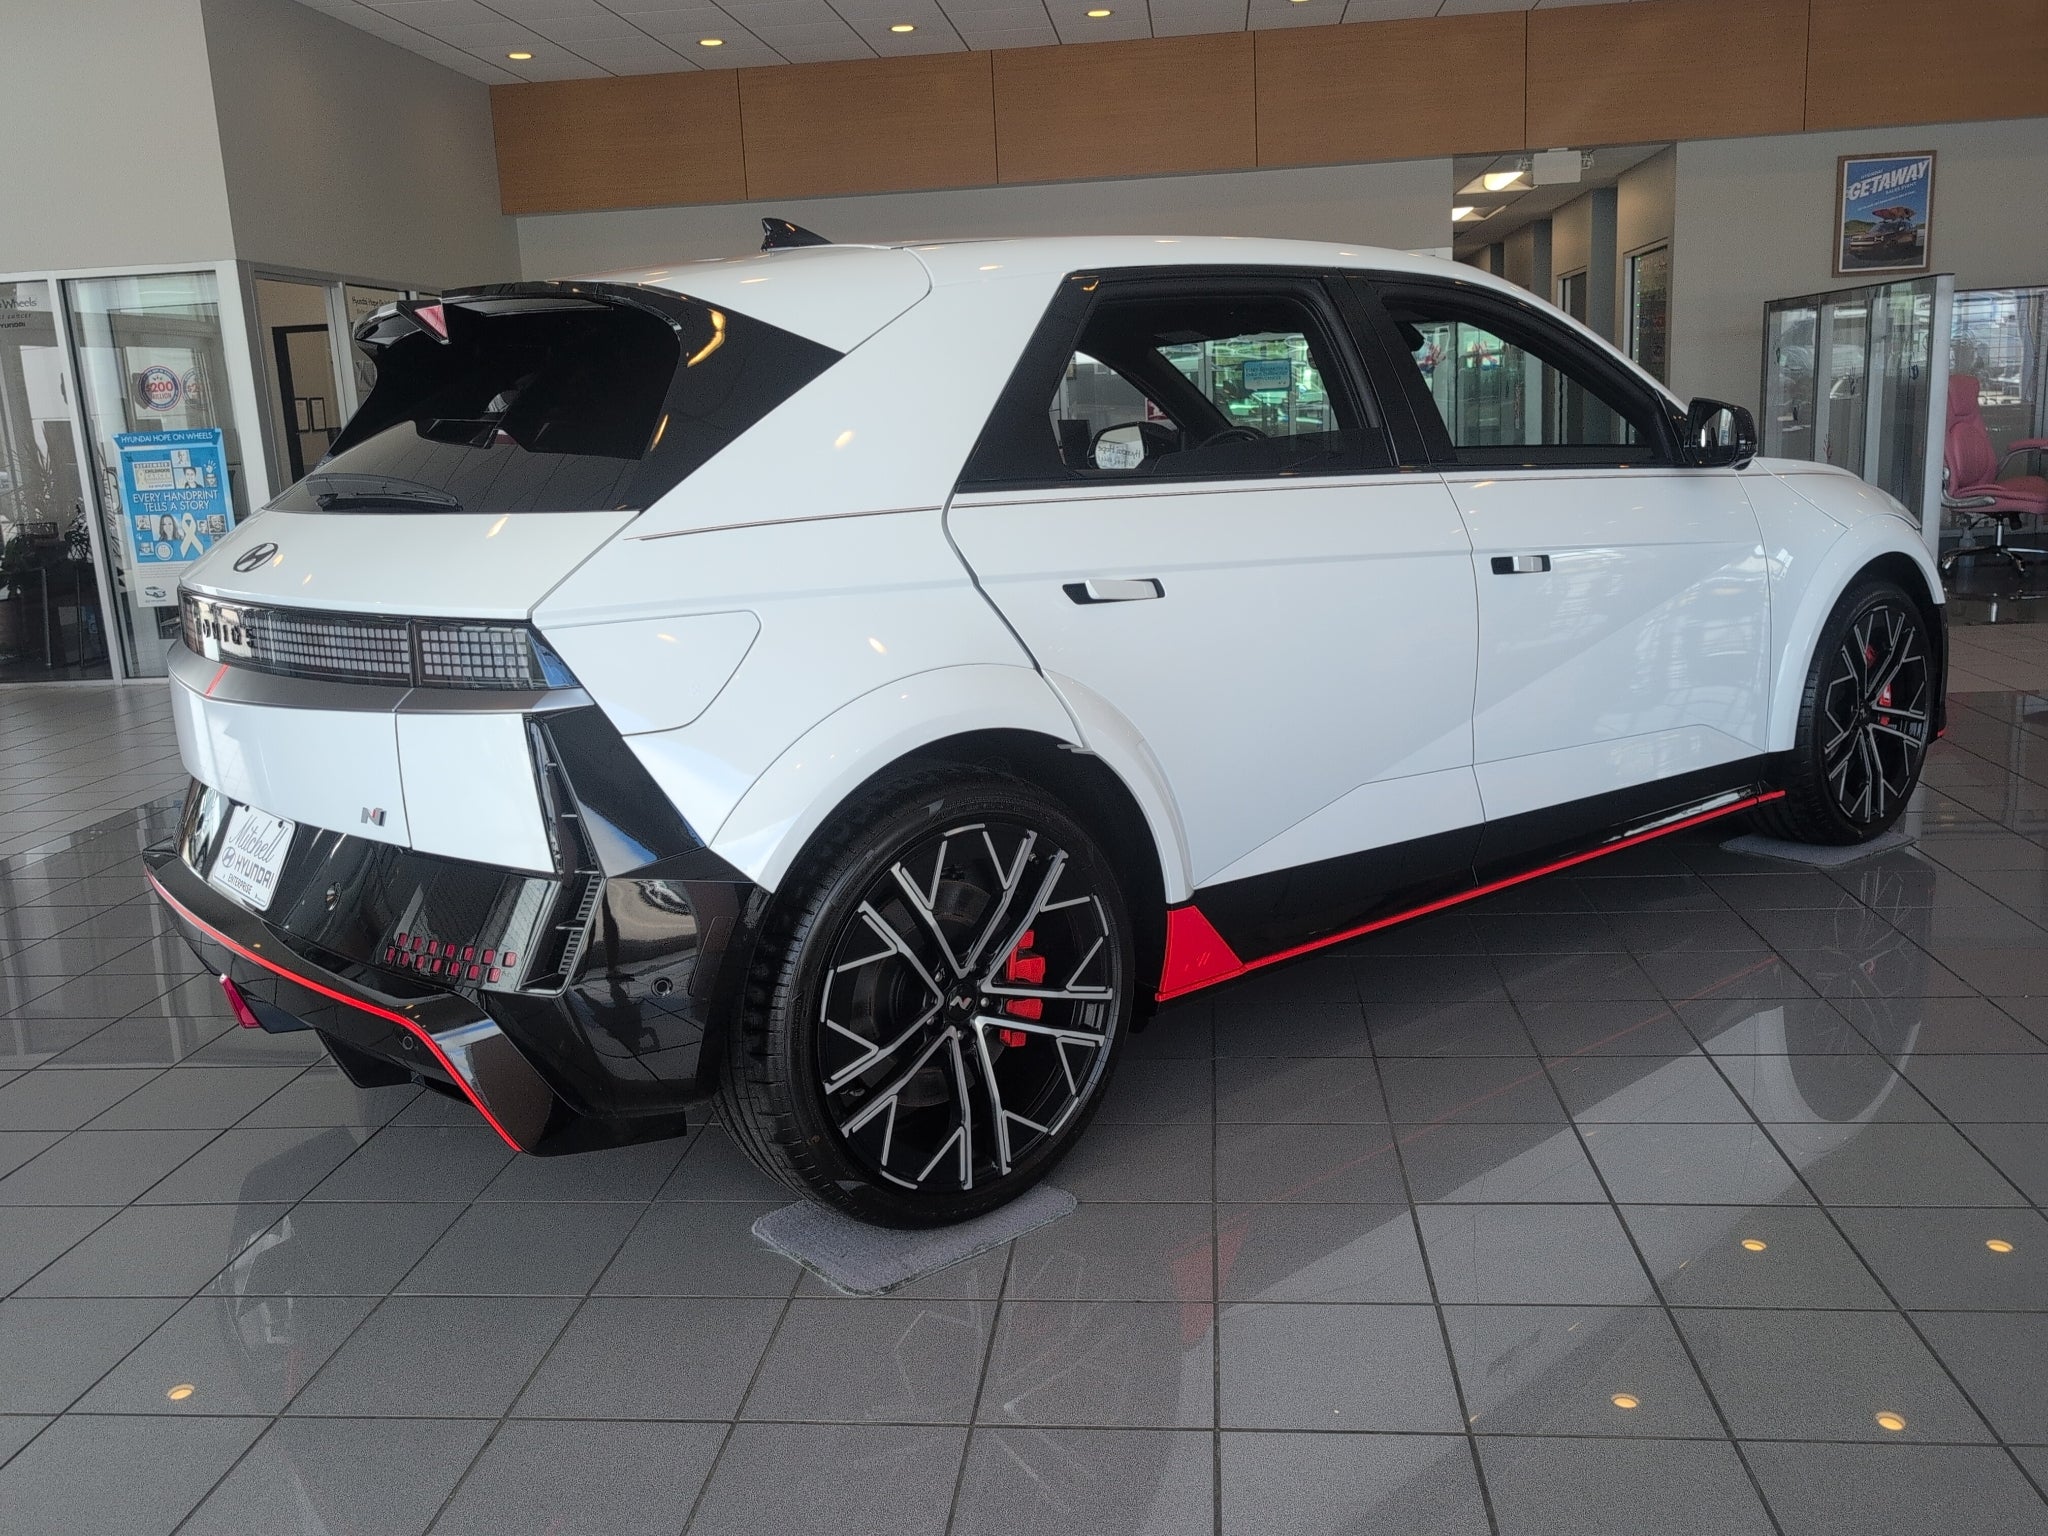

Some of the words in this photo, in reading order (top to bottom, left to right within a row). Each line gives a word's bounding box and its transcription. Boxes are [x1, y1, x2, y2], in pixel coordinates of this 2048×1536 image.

[1847, 160, 1930, 200] GETAWAY
[1, 296, 38, 309] Wheels
[121, 435, 152, 443] HYUNDAI
[153, 434, 172, 442] HOPE
[173, 433, 185, 441] ON
[187, 432, 213, 440] WHEELS
[133, 492, 160, 503] EVERY
[164, 490, 218, 502] HANDPRINT
[144, 502, 167, 512] TELLS
[170, 502, 178, 511] A
[180, 500, 210, 511] STORY
[229, 814, 289, 864] Mitchell
[234, 854, 275, 890] HYUNDAI
[228, 873, 253, 895] ENTERPRISE
